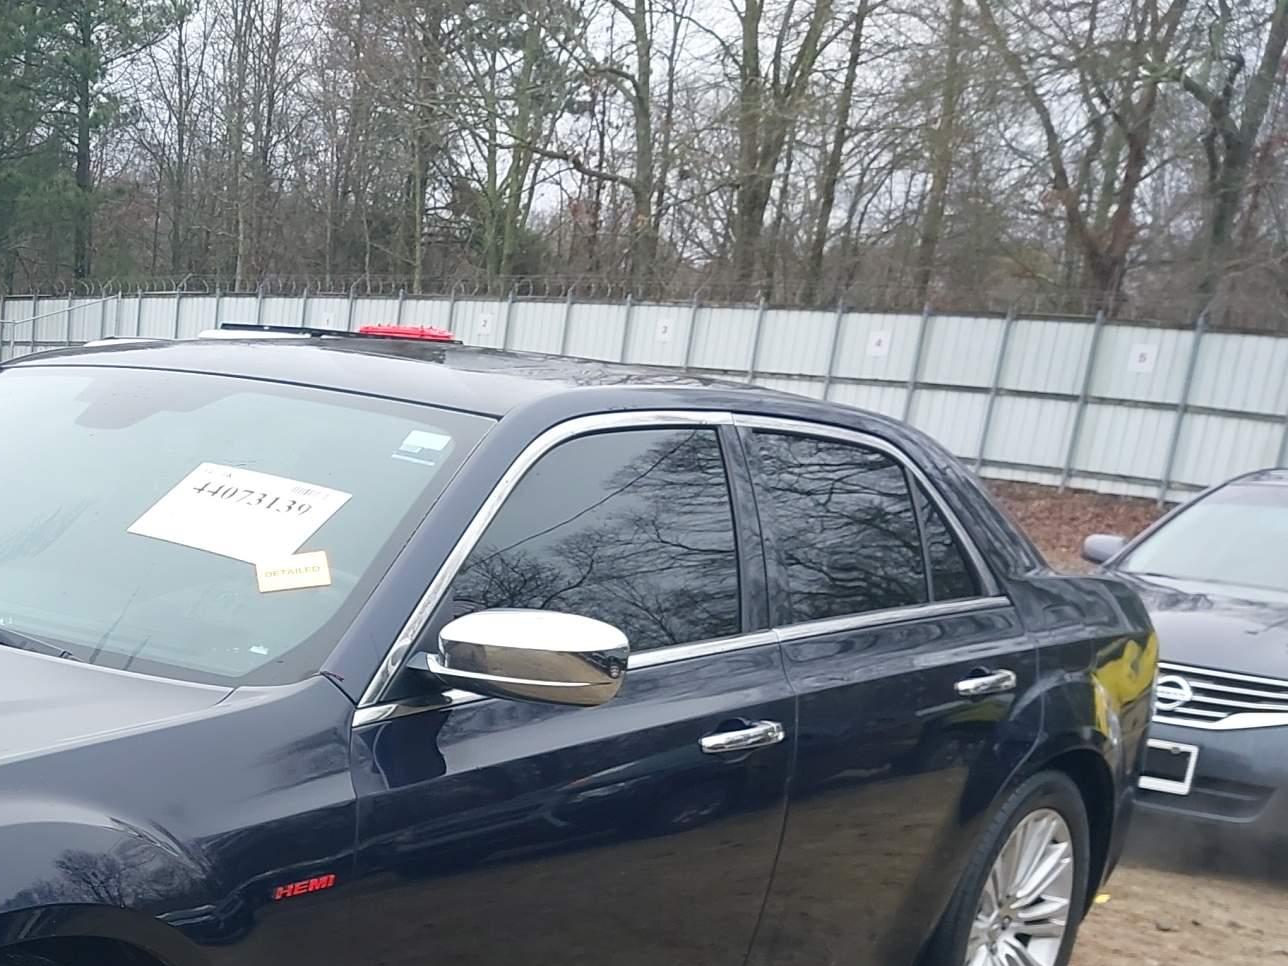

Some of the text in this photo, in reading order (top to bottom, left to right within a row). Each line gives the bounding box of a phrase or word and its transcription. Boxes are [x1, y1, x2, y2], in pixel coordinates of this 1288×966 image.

[193, 481, 313, 516] 44073139
[264, 565, 321, 577] DETAILED
[274, 874, 336, 900] HEMI
